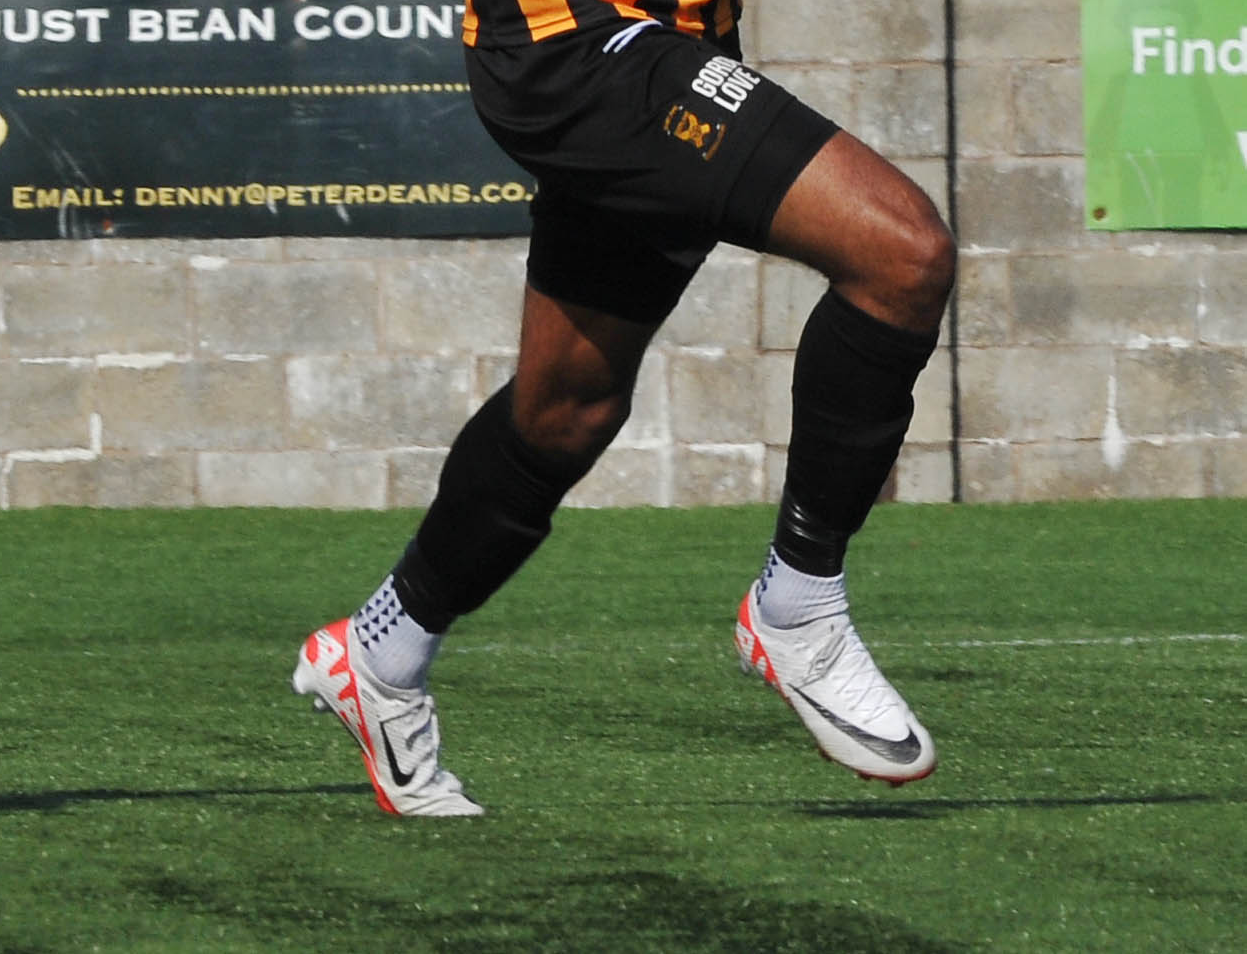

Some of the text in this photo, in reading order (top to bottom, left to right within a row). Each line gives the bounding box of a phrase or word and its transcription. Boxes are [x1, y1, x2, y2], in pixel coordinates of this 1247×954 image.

[129, 7, 275, 42] BEAN
[1132, 26, 1247, 75] Find
[713, 67, 761, 113] LOVE
[12, 185, 124, 210] EMAIL:
[135, 181, 538, 209] DENNY@PETERDEANS.CO.
